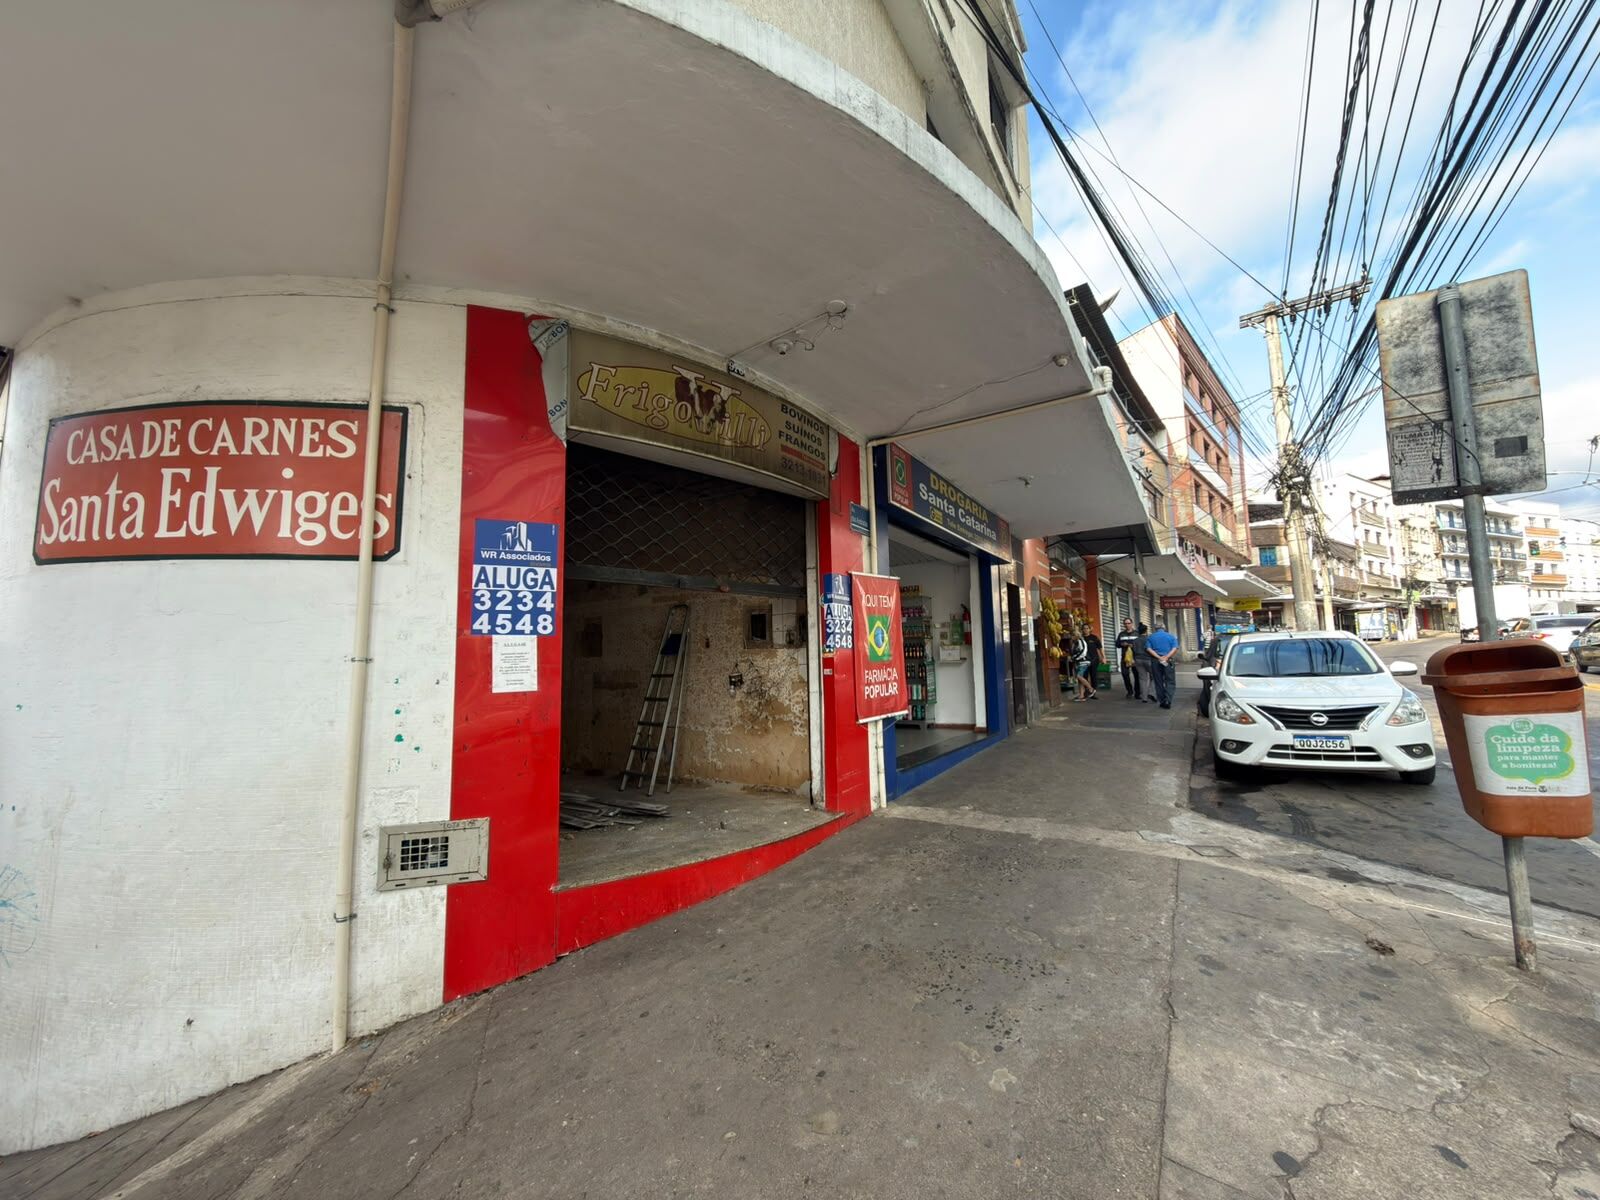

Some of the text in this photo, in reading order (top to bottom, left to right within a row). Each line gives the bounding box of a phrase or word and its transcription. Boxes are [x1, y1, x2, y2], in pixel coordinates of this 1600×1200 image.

[781, 403, 824, 435] BOVINOS
[66, 417, 359, 465] CASA DE CARNES
[785, 420, 822, 446] SUINOS
[778, 430, 826, 460] FRANGOS
[39, 466, 393, 547] Santa Edwiges
[929, 472, 989, 523] DROGARIA
[919, 482, 956, 518] Santa
[958, 508, 997, 541] Catarina
[481, 550, 552, 562] WR Associados
[474, 566, 555, 590] ALUGA
[474, 590, 554, 612] 3234
[825, 604, 853, 619] ALUGA
[472, 612, 554, 635] 4548
[826, 619, 853, 634] 3234
[826, 634, 853, 649] 4548
[864, 682, 898, 699] POPULAR
[1490, 733, 1560, 744] Cuide da
[1496, 743, 1561, 754] limpeza
[1497, 754, 1520, 762] para
